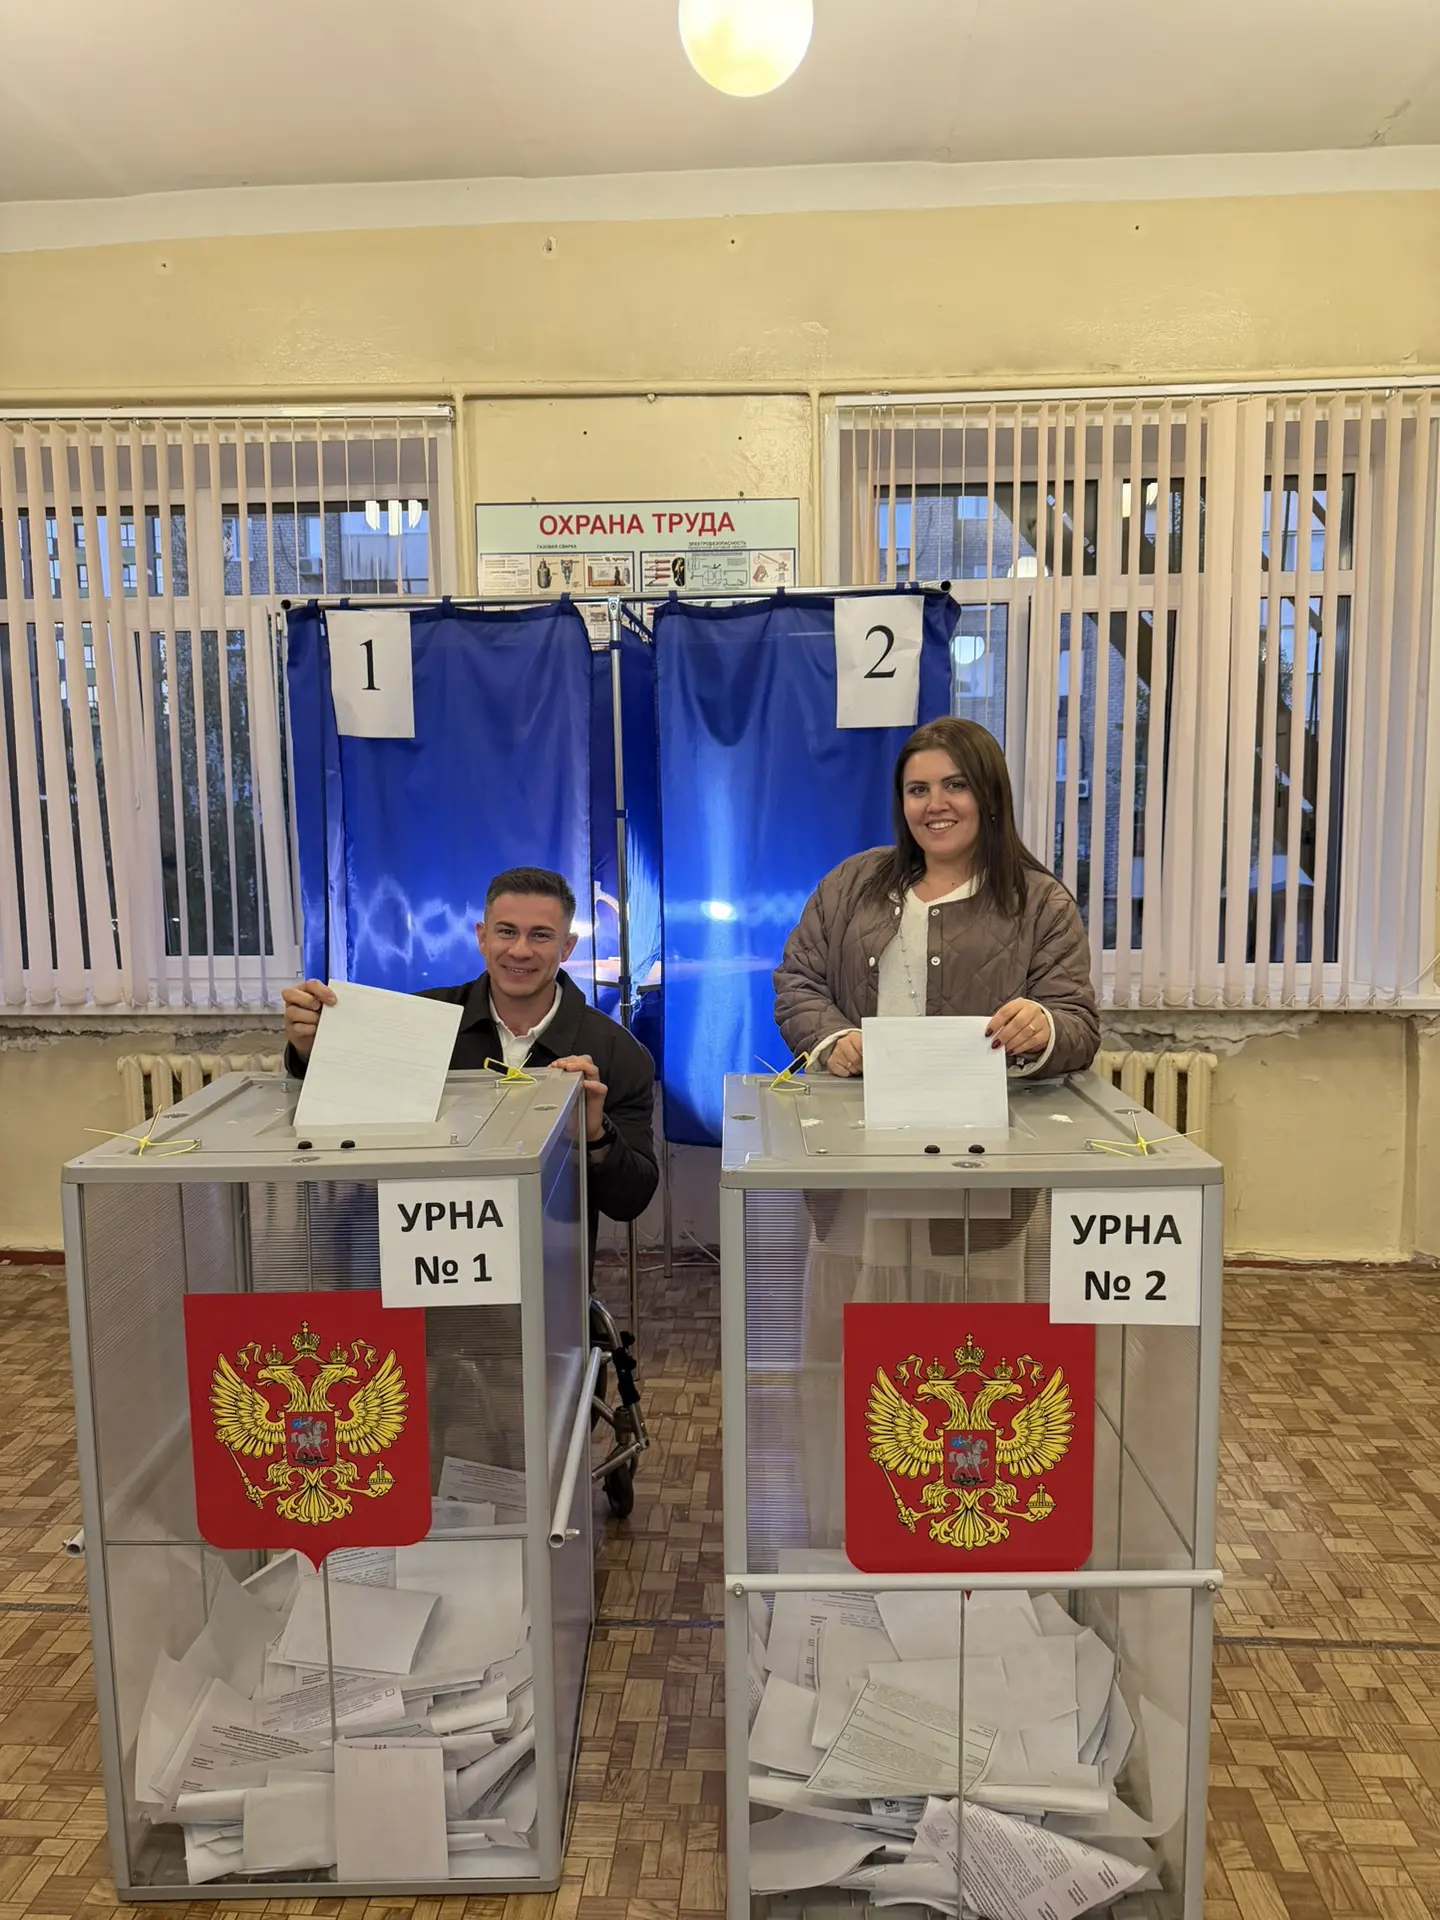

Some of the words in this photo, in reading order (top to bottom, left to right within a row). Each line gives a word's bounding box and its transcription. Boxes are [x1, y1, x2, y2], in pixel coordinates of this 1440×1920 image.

[539, 514, 645, 536] ОХРАНА
[651, 511, 736, 537] ТРУДА
[359, 639, 381, 691] 1
[863, 624, 897, 679] 2
[397, 1199, 504, 1233] УРНА
[1070, 1214, 1182, 1246] УРНА
[414, 1255, 459, 1286] №
[472, 1252, 493, 1283] 1
[1084, 1270, 1131, 1301] №
[1145, 1270, 1167, 1301] 2
